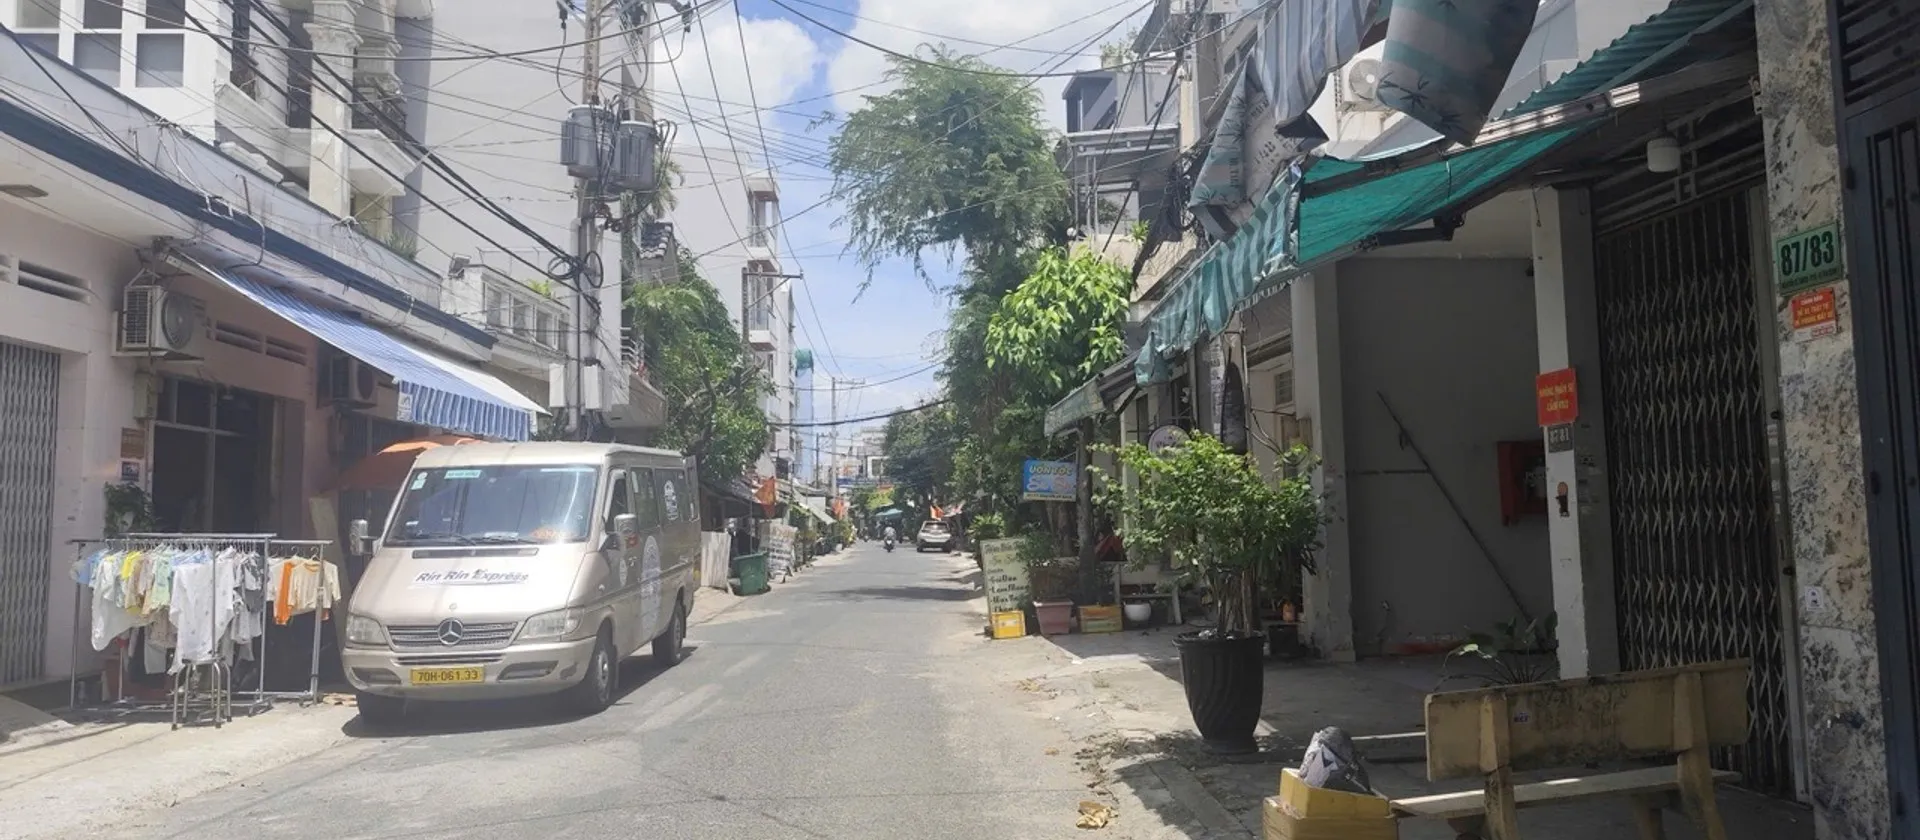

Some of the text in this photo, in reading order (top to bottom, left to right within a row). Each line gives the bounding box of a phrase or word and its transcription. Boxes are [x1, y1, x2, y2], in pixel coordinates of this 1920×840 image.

[1781, 231, 1835, 276] 87/83
[415, 568, 529, 582] Rin Rin Express
